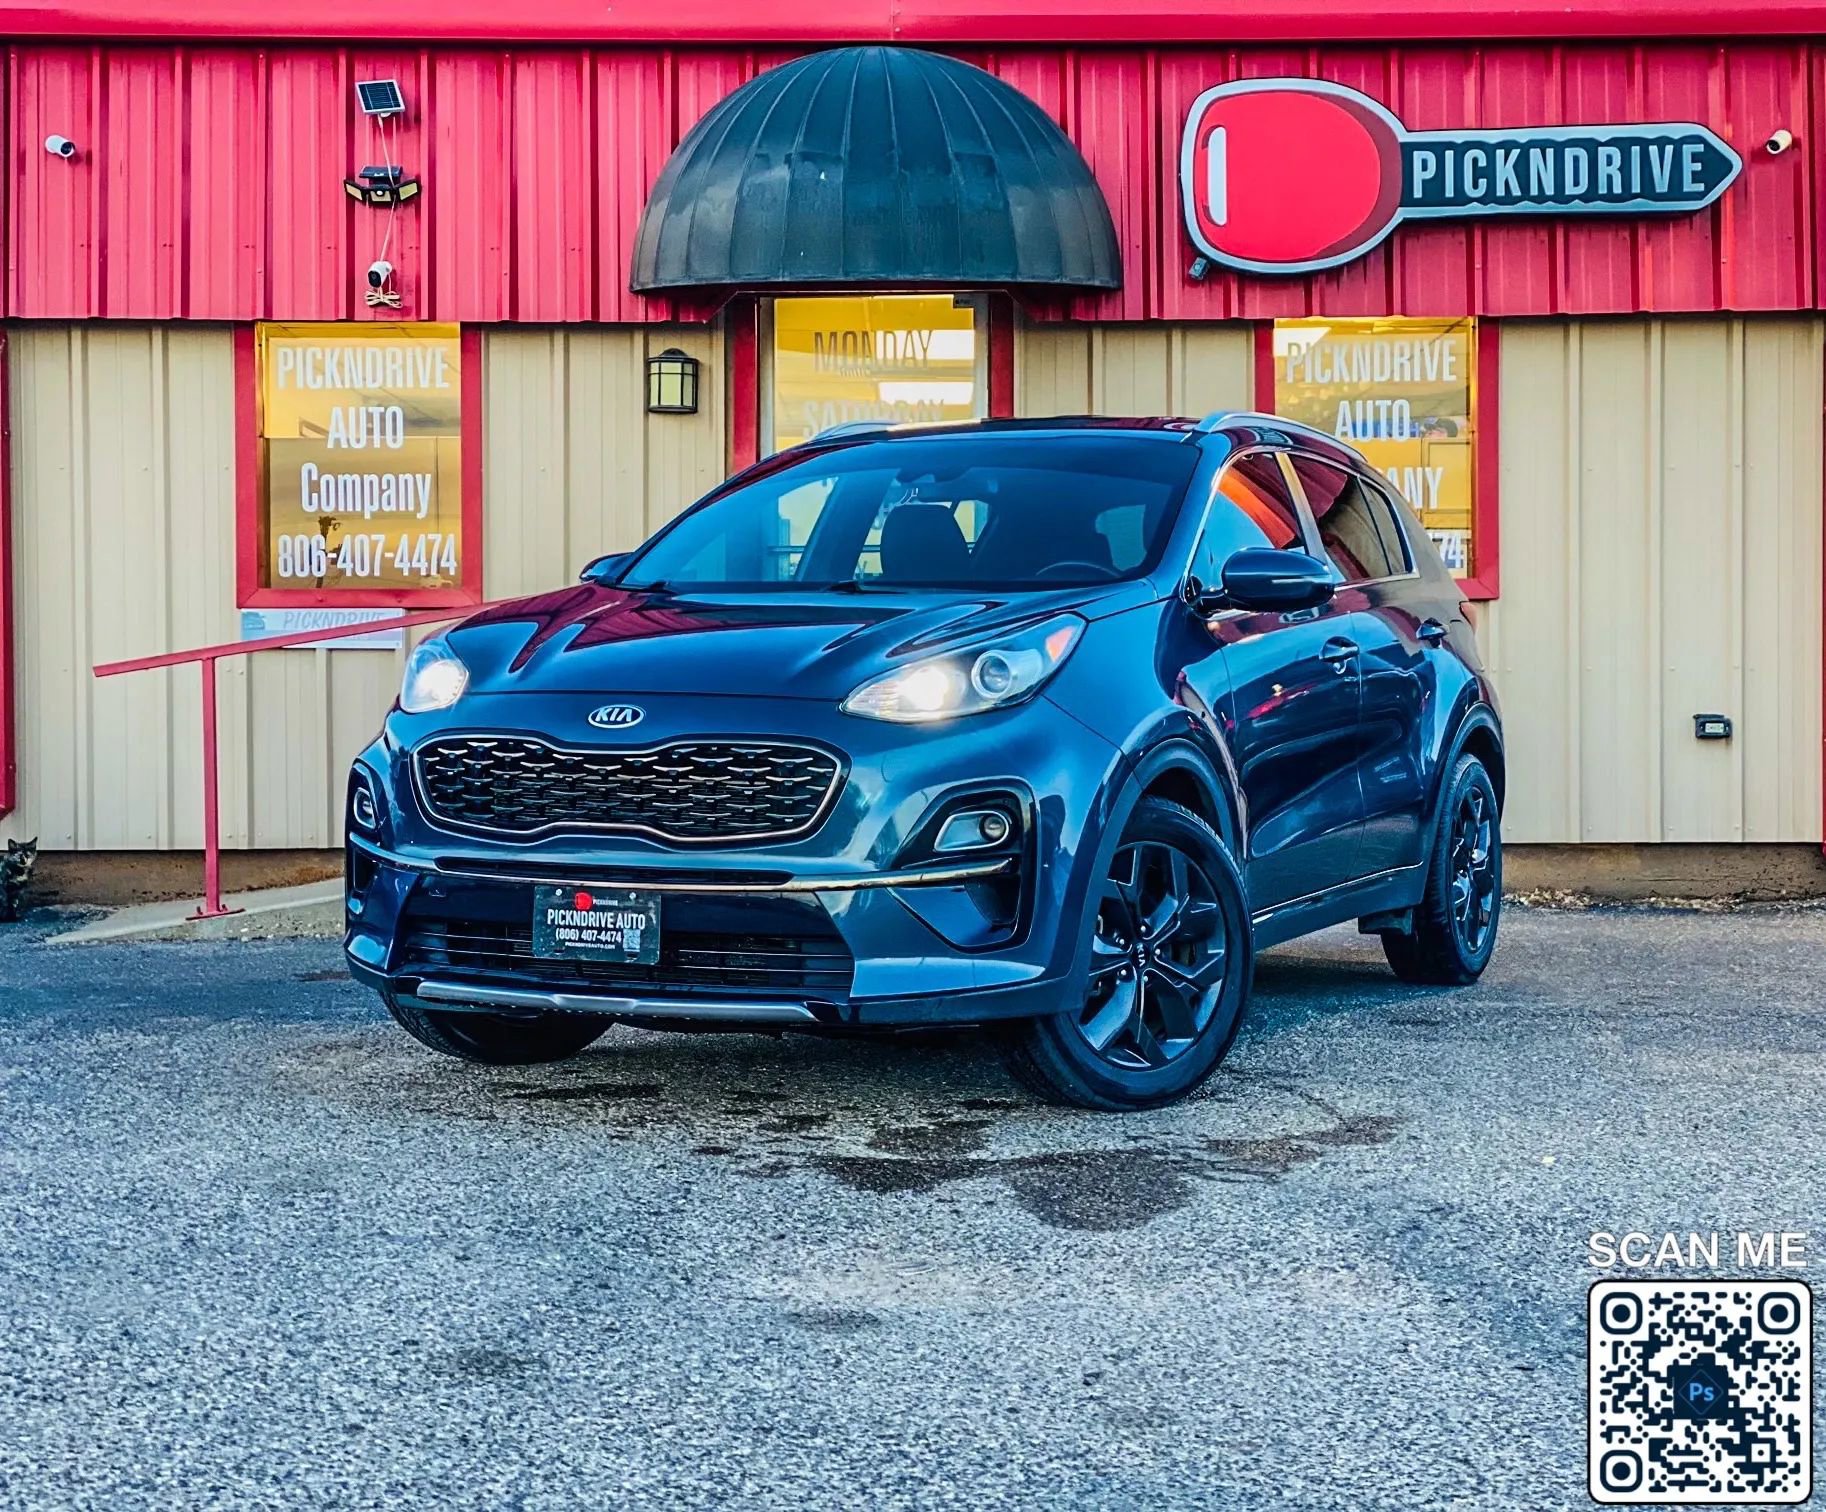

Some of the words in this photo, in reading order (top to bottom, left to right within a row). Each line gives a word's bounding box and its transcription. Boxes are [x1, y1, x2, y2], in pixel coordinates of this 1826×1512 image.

[1413, 143, 1705, 199] PICKNDRIVE
[277, 346, 449, 389] PICKNDRIVE
[814, 330, 933, 371] MONDAY
[1286, 339, 1456, 384] PICKNDRIVE
[327, 406, 404, 449] AUTO
[1335, 399, 1411, 442] AUTO
[301, 462, 431, 520] Company
[278, 533, 457, 577] 806-407-4474
[595, 707, 633, 722] KIA
[547, 908, 614, 929] PICKNDRIVE
[615, 912, 646, 930] AUTO
[555, 928, 579, 941] (806)
[581, 930, 622, 943] 407-4474
